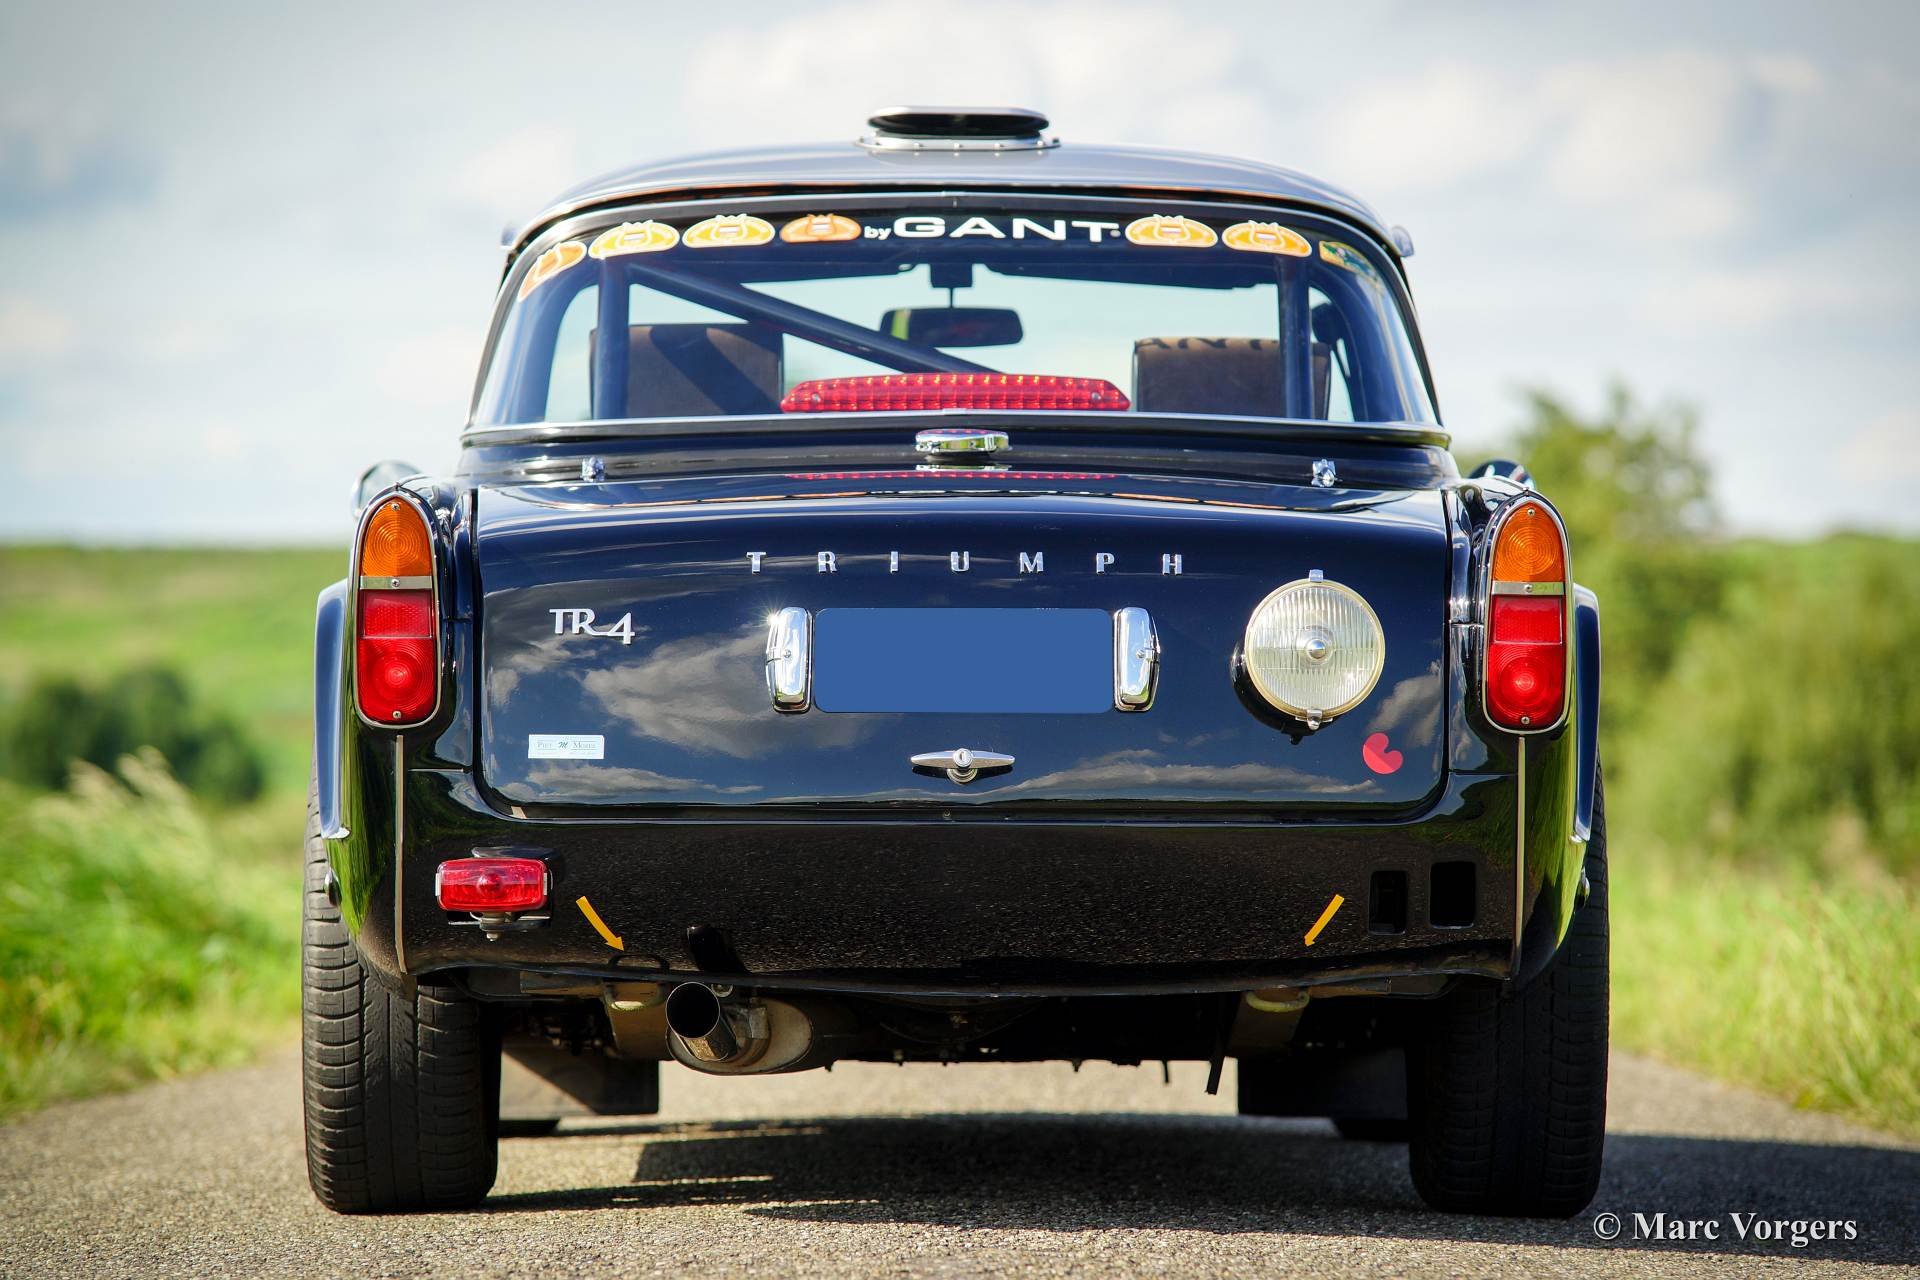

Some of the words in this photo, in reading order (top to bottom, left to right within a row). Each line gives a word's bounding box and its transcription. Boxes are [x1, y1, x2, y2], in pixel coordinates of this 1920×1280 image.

[864, 226, 891, 240] by
[893, 217, 1119, 242] GANT
[746, 551, 1183, 574] TRIUMPH
[549, 608, 636, 645] TR4
